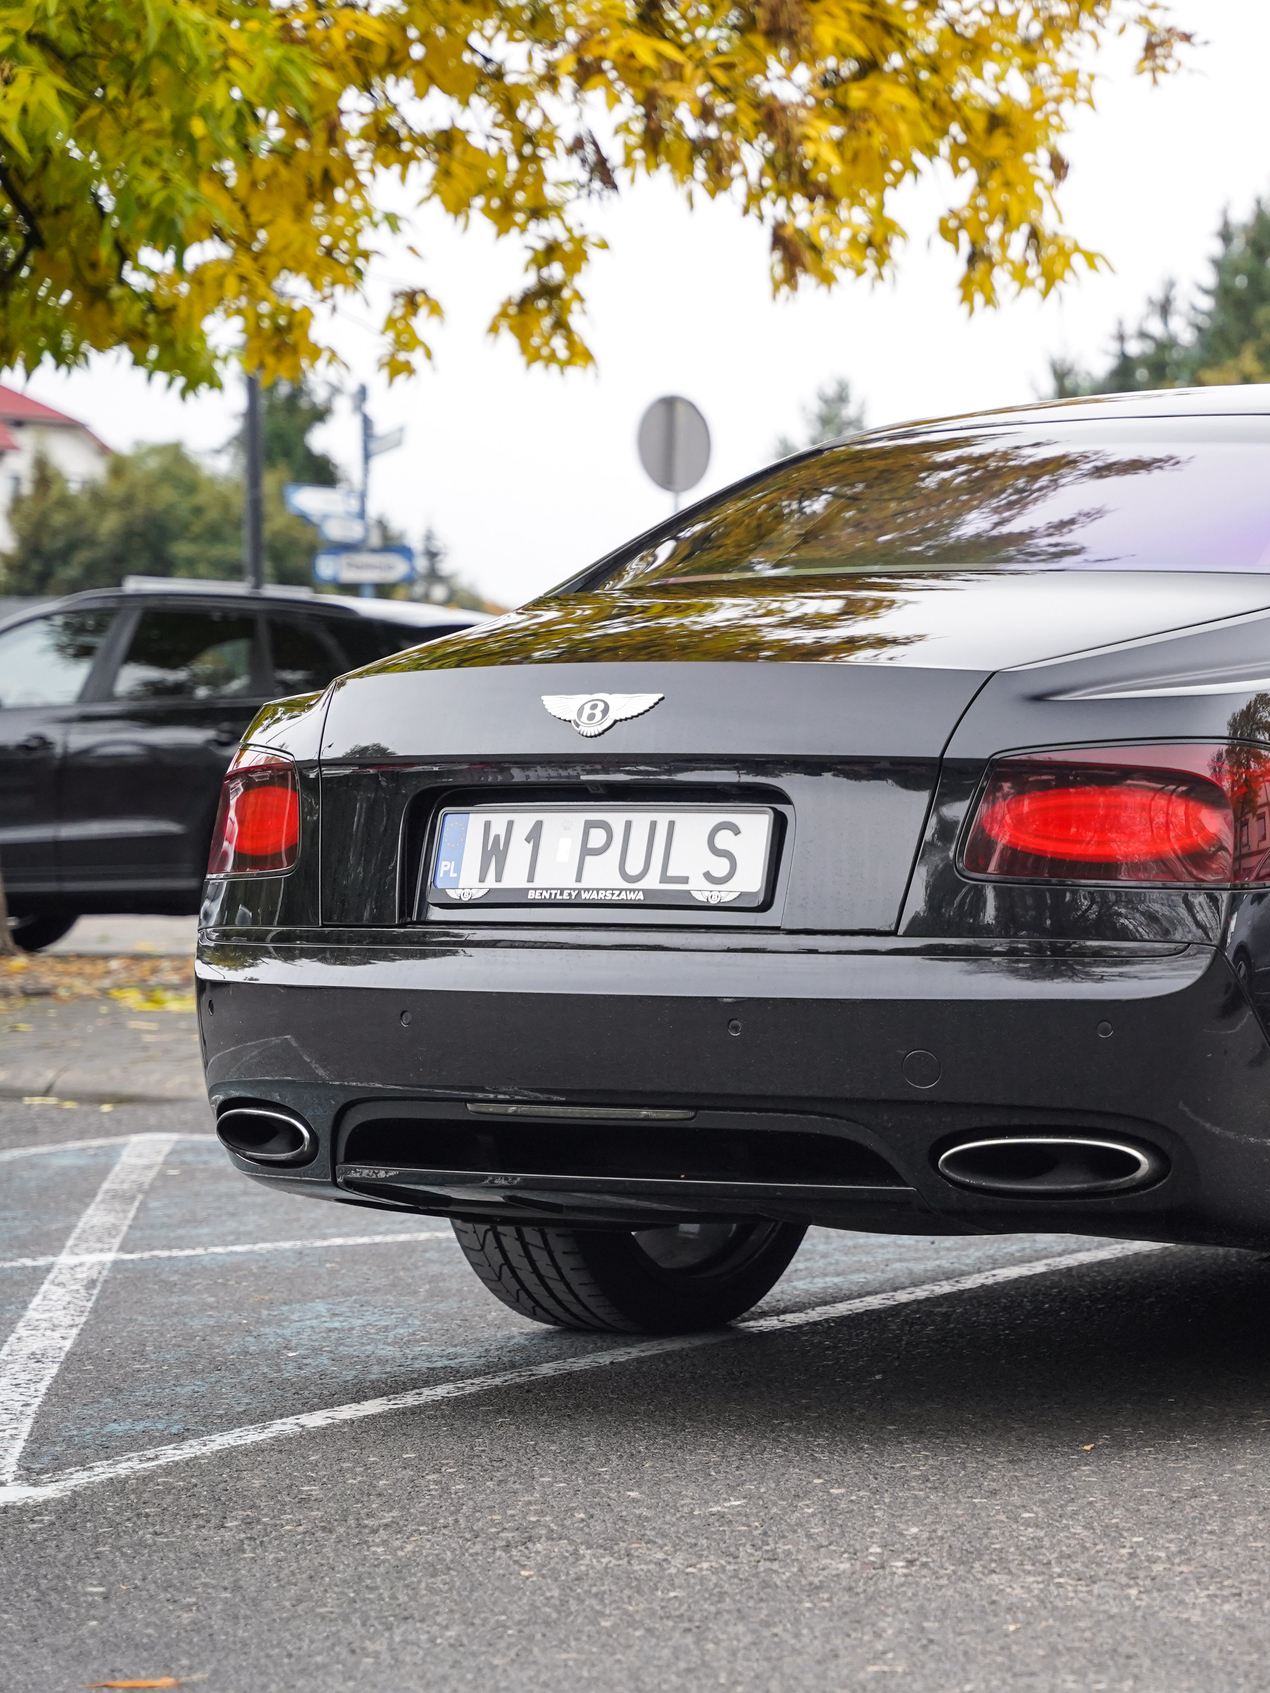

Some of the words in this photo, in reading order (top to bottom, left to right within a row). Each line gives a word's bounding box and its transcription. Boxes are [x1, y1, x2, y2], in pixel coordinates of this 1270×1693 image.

[582, 700, 605, 724] B
[478, 819, 544, 883] W1
[574, 819, 743, 885] PULS
[439, 860, 458, 878] PL
[527, 889, 578, 900] BENTLEY
[580, 889, 645, 901] WARSZAWA
